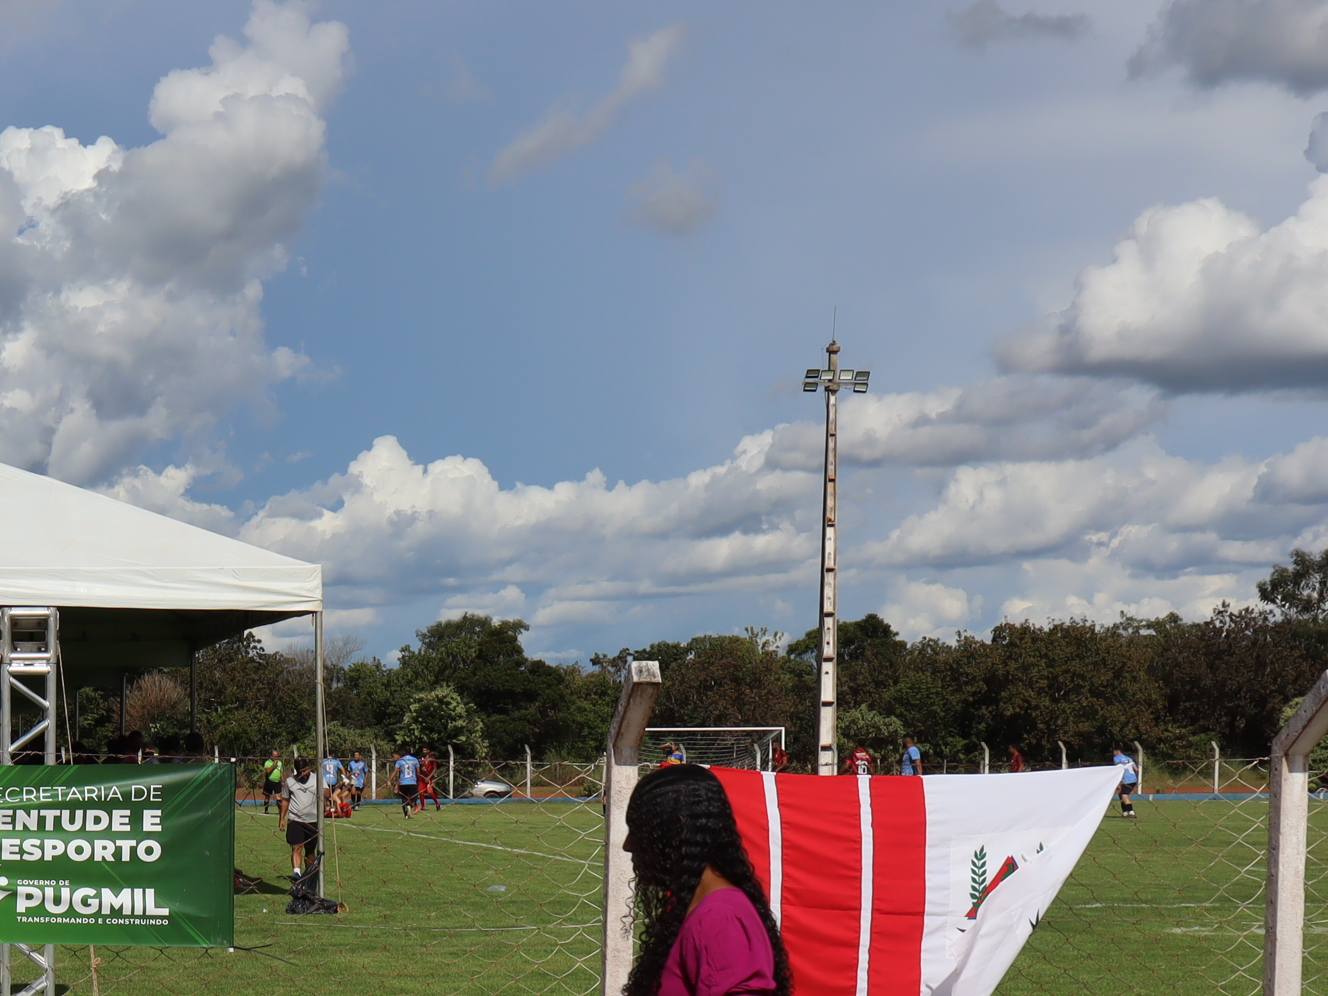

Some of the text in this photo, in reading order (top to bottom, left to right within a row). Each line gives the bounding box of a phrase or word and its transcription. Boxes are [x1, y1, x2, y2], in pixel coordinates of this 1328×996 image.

[131, 784, 163, 802] DE
[143, 809, 162, 832] E
[16, 886, 170, 916] PUGMIL
[16, 916, 95, 924] TRANSFORMANDO
[106, 918, 169, 926] CONSTRUINDO
